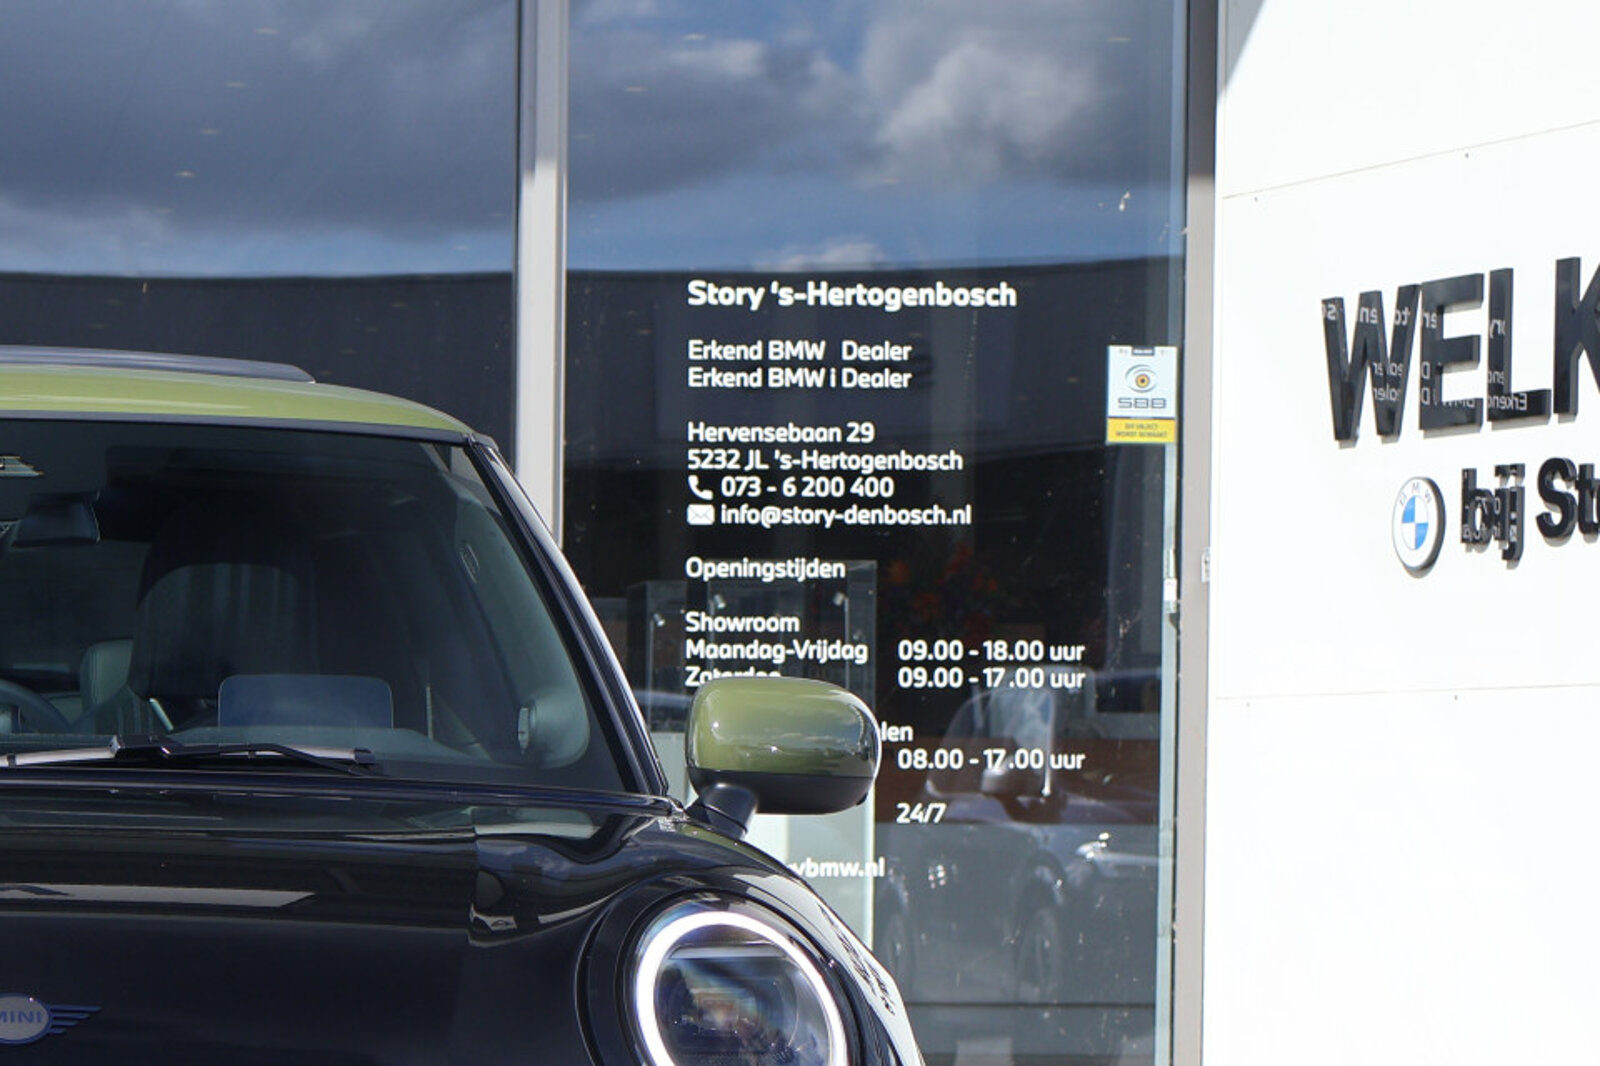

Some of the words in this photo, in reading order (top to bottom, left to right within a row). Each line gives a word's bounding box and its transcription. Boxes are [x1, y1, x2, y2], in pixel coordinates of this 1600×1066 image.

[687, 280, 765, 311] Story
[687, 339, 763, 362] Erkend
[767, 339, 827, 362] BMW
[841, 339, 913, 362] Dealer
[687, 367, 763, 389] Erkend
[767, 367, 827, 389] BMW
[829, 367, 838, 389] i
[841, 367, 913, 389] Dealer
[687, 422, 843, 444] Hervensebaan
[847, 422, 875, 444] 29
[687, 449, 742, 471] 5232
[745, 449, 769, 472] JL
[720, 476, 759, 498] 073
[782, 476, 797, 499] 6
[802, 476, 845, 499] 200
[850, 476, 895, 499] 400
[720, 503, 973, 530] info@story-denbosch.nl
[1460, 463, 1526, 560] bij
[1535, 457, 1600, 540] St
[685, 556, 846, 583] Openingstijden
[684, 611, 801, 635] Showroom
[684, 639, 870, 667] Maandag-Vrijdag
[898, 639, 963, 663] 09.00
[984, 639, 1045, 663] 18.00
[1049, 644, 1087, 663] uur
[898, 667, 963, 690] 09.00
[1049, 672, 1087, 690] uur
[897, 748, 963, 772] 08.00
[1049, 754, 1087, 772] uur
[896, 802, 947, 825] 24/7
